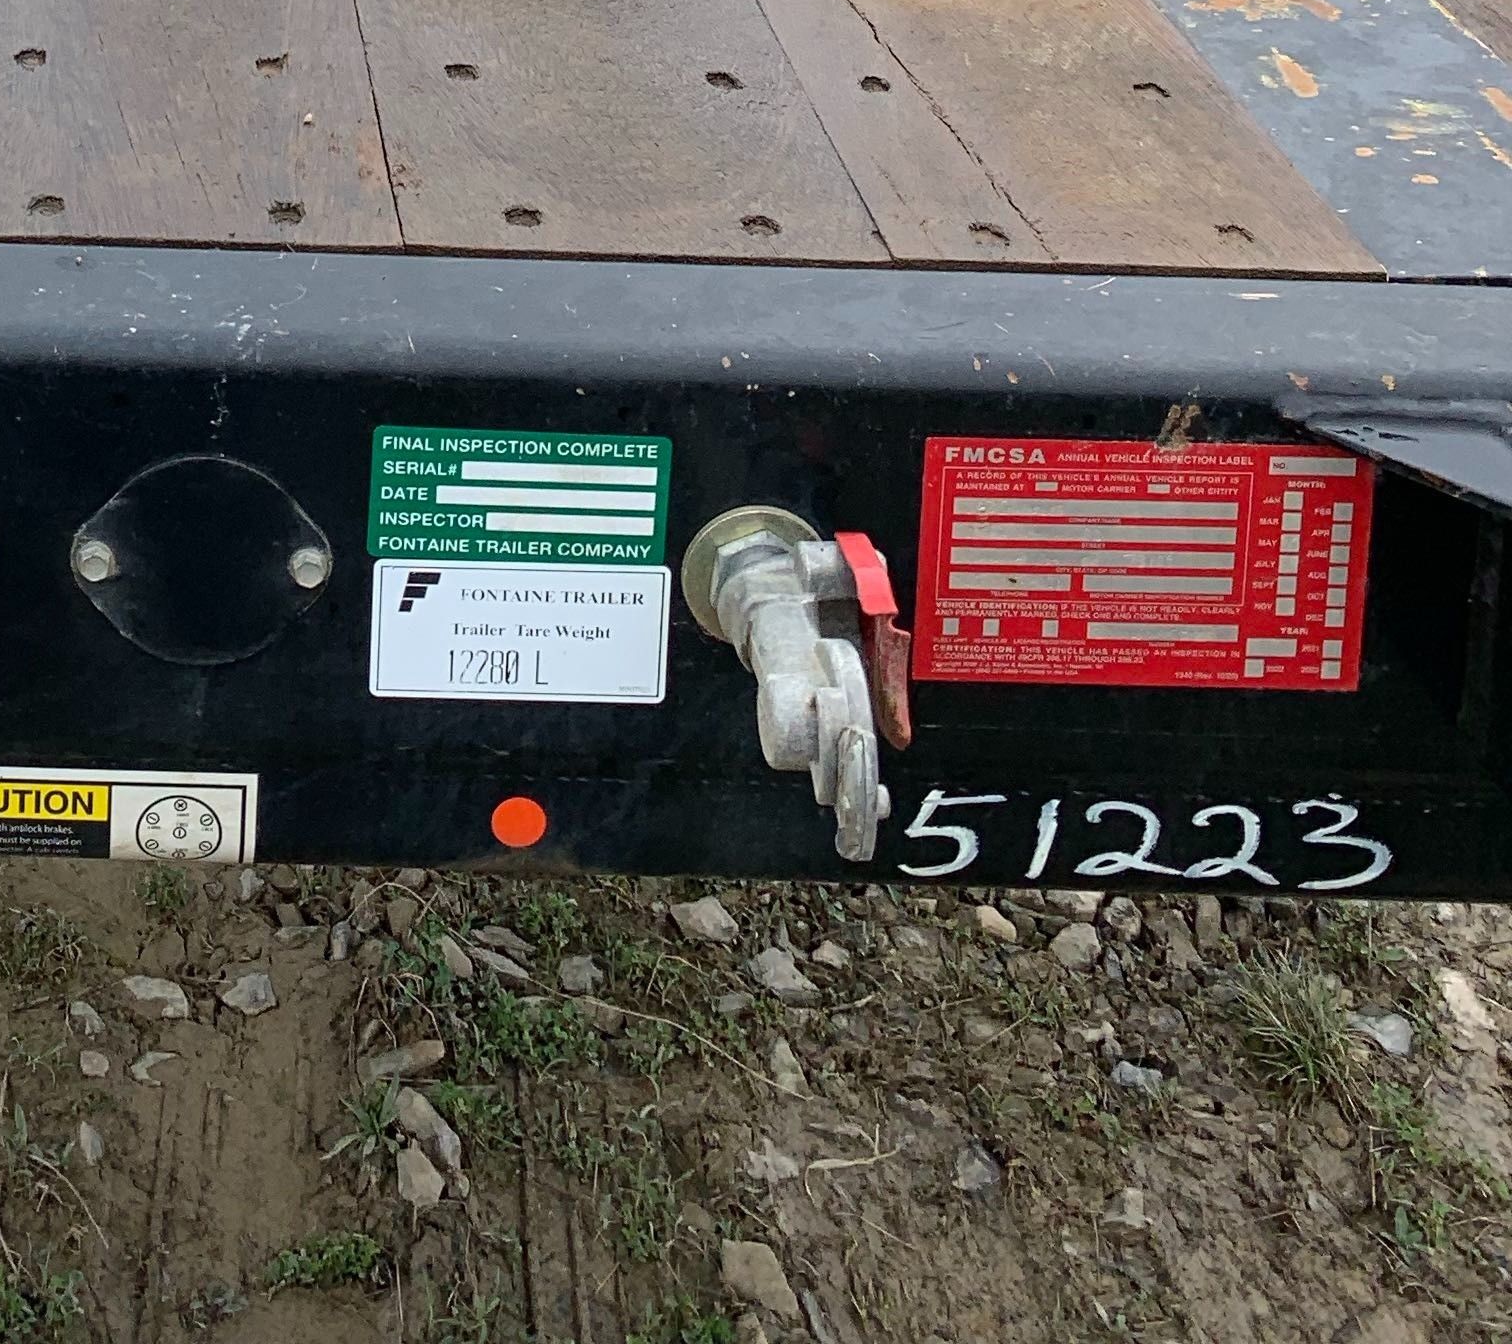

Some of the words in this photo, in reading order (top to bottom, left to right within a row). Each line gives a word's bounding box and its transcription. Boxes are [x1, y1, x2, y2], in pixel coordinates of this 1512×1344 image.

[382, 436, 434, 452] FINAL
[440, 438, 552, 455] INSPECTION
[557, 441, 659, 459] COMPLETE
[945, 446, 1046, 464] FMCSA
[1057, 453, 1099, 462] ANNUAL
[1104, 453, 1150, 464] VEHICLE
[1152, 455, 1217, 465] INSPECTION
[1219, 455, 1254, 466] LABEL
[382, 460, 457, 476] SERIAL#
[967, 472, 1006, 480] RECORD
[380, 486, 429, 501] DATE
[379, 512, 484, 528] INSPECTOR
[378, 536, 470, 553] FONTAINE
[476, 539, 552, 556] TRAILER
[557, 542, 652, 559] COMPANY
[460, 588, 557, 604] FONTAINE
[560, 590, 645, 606] TRAILER
[451, 623, 506, 638] Trailer
[514, 624, 551, 638] Tare
[555, 625, 611, 641] Weight
[449, 649, 520, 685] 12280
[534, 650, 549, 685] L
[19, 835, 31, 844] be
[32, 836, 69, 847] supplied
[897, 788, 1393, 890] 51223
